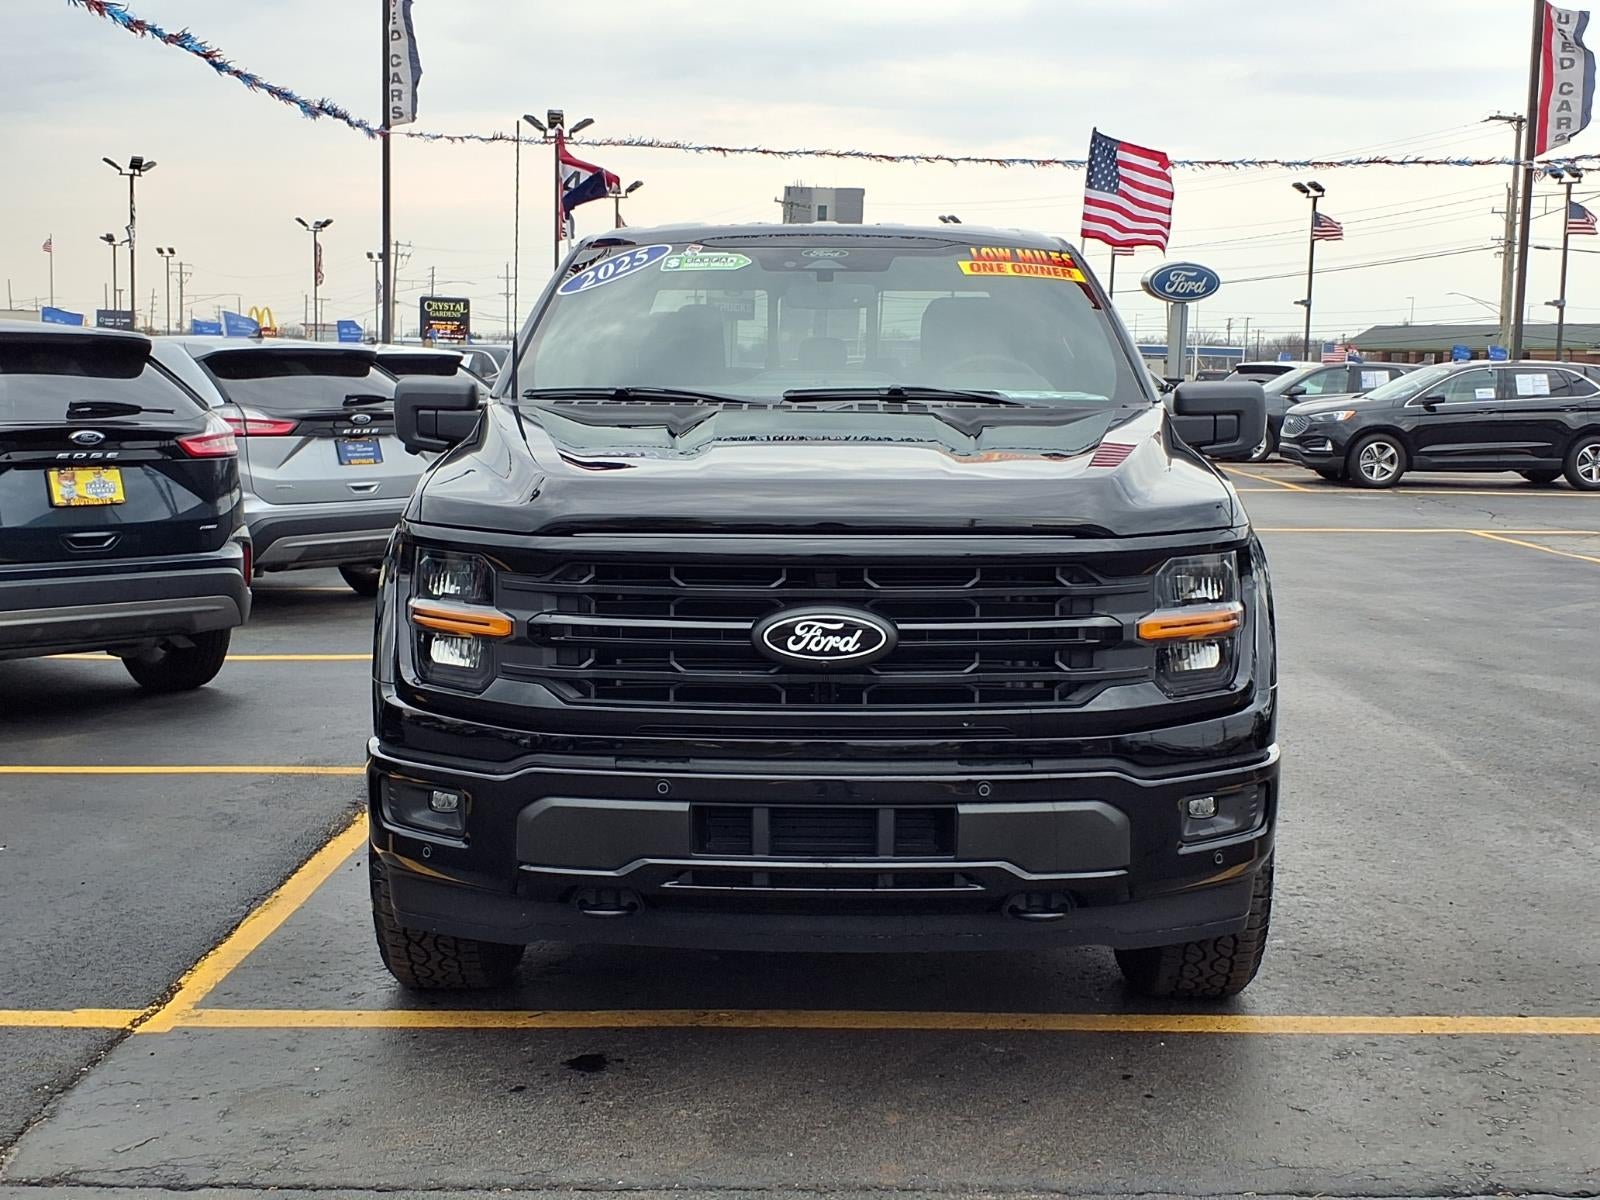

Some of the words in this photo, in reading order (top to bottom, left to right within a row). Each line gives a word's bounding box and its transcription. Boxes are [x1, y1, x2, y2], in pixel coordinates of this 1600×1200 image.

[390, 54, 404, 119] CARS
[1554, 82, 1574, 142] CARS
[579, 248, 649, 289] 2025
[969, 262, 1006, 273] ONE
[1011, 263, 1073, 278] OWNER
[970, 247, 1012, 261] LOW
[1016, 248, 1075, 268] MILES
[1165, 270, 1207, 293] Ford
[424, 300, 467, 313] CRYSTAL
[787, 621, 863, 651] Ford
